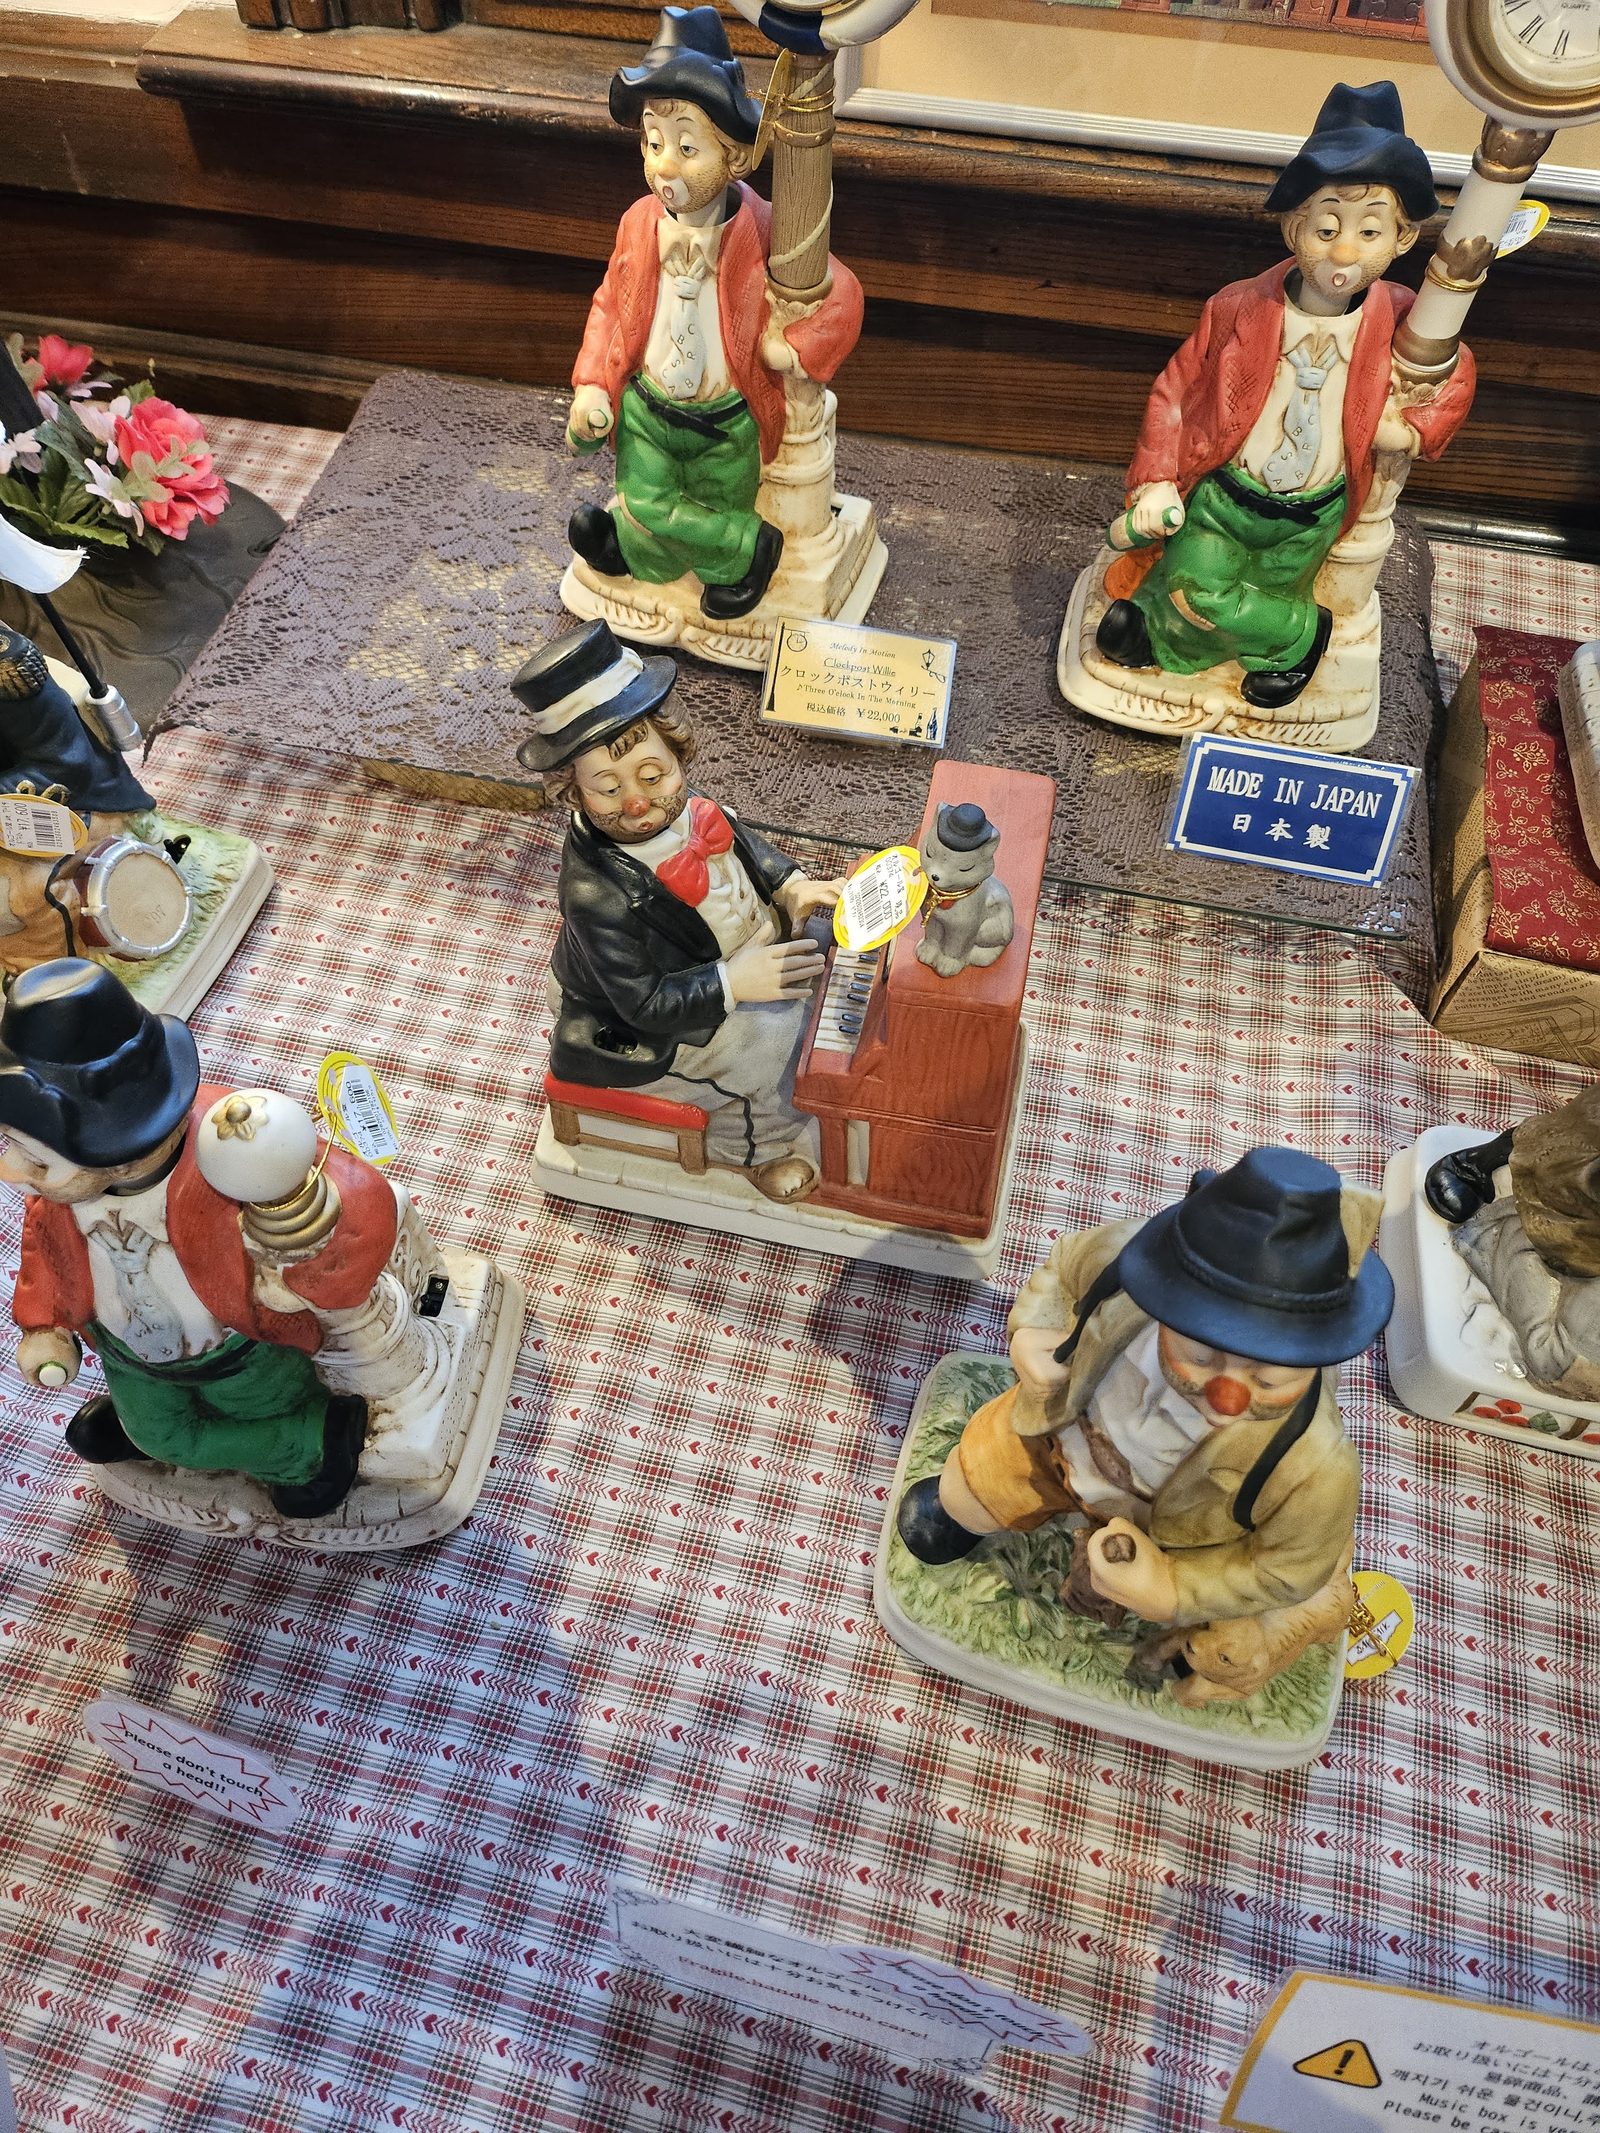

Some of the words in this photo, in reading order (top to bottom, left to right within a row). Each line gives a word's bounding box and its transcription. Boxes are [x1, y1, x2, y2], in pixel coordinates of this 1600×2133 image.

[830, 641, 858, 653] Melody
[859, 646, 868, 654] In
[869, 648, 896, 659] Motion
[823, 657, 871, 674] Clockpost
[872, 664, 897, 677] Willie
[803, 684, 826, 696] Three
[857, 692, 866, 701] In
[868, 694, 884, 704] The
[885, 697, 917, 710] Morning
[806, 702, 847, 717] 税込価格
[1206, 765, 1264, 799] MADE
[1273, 777, 1304, 806] IN
[1310, 784, 1383, 819] JAPAN
[1231, 813, 1332, 851] 日本製
[124, 1729, 172, 1759] Please
[176, 1753, 216, 1779] don't
[220, 1772, 264, 1798] touch
[162, 1761, 173, 1772] a
[176, 1765, 227, 1795] head!!
[827, 2003, 872, 2022] with
[1391, 2068, 1449, 2091] 깨지기
[1384, 2099, 1443, 2124] Please
[1450, 2115, 1472, 2131] be
[1418, 2092, 1469, 2114] Music
[1478, 2105, 1509, 2123] box
[1519, 2115, 1538, 2131] is
